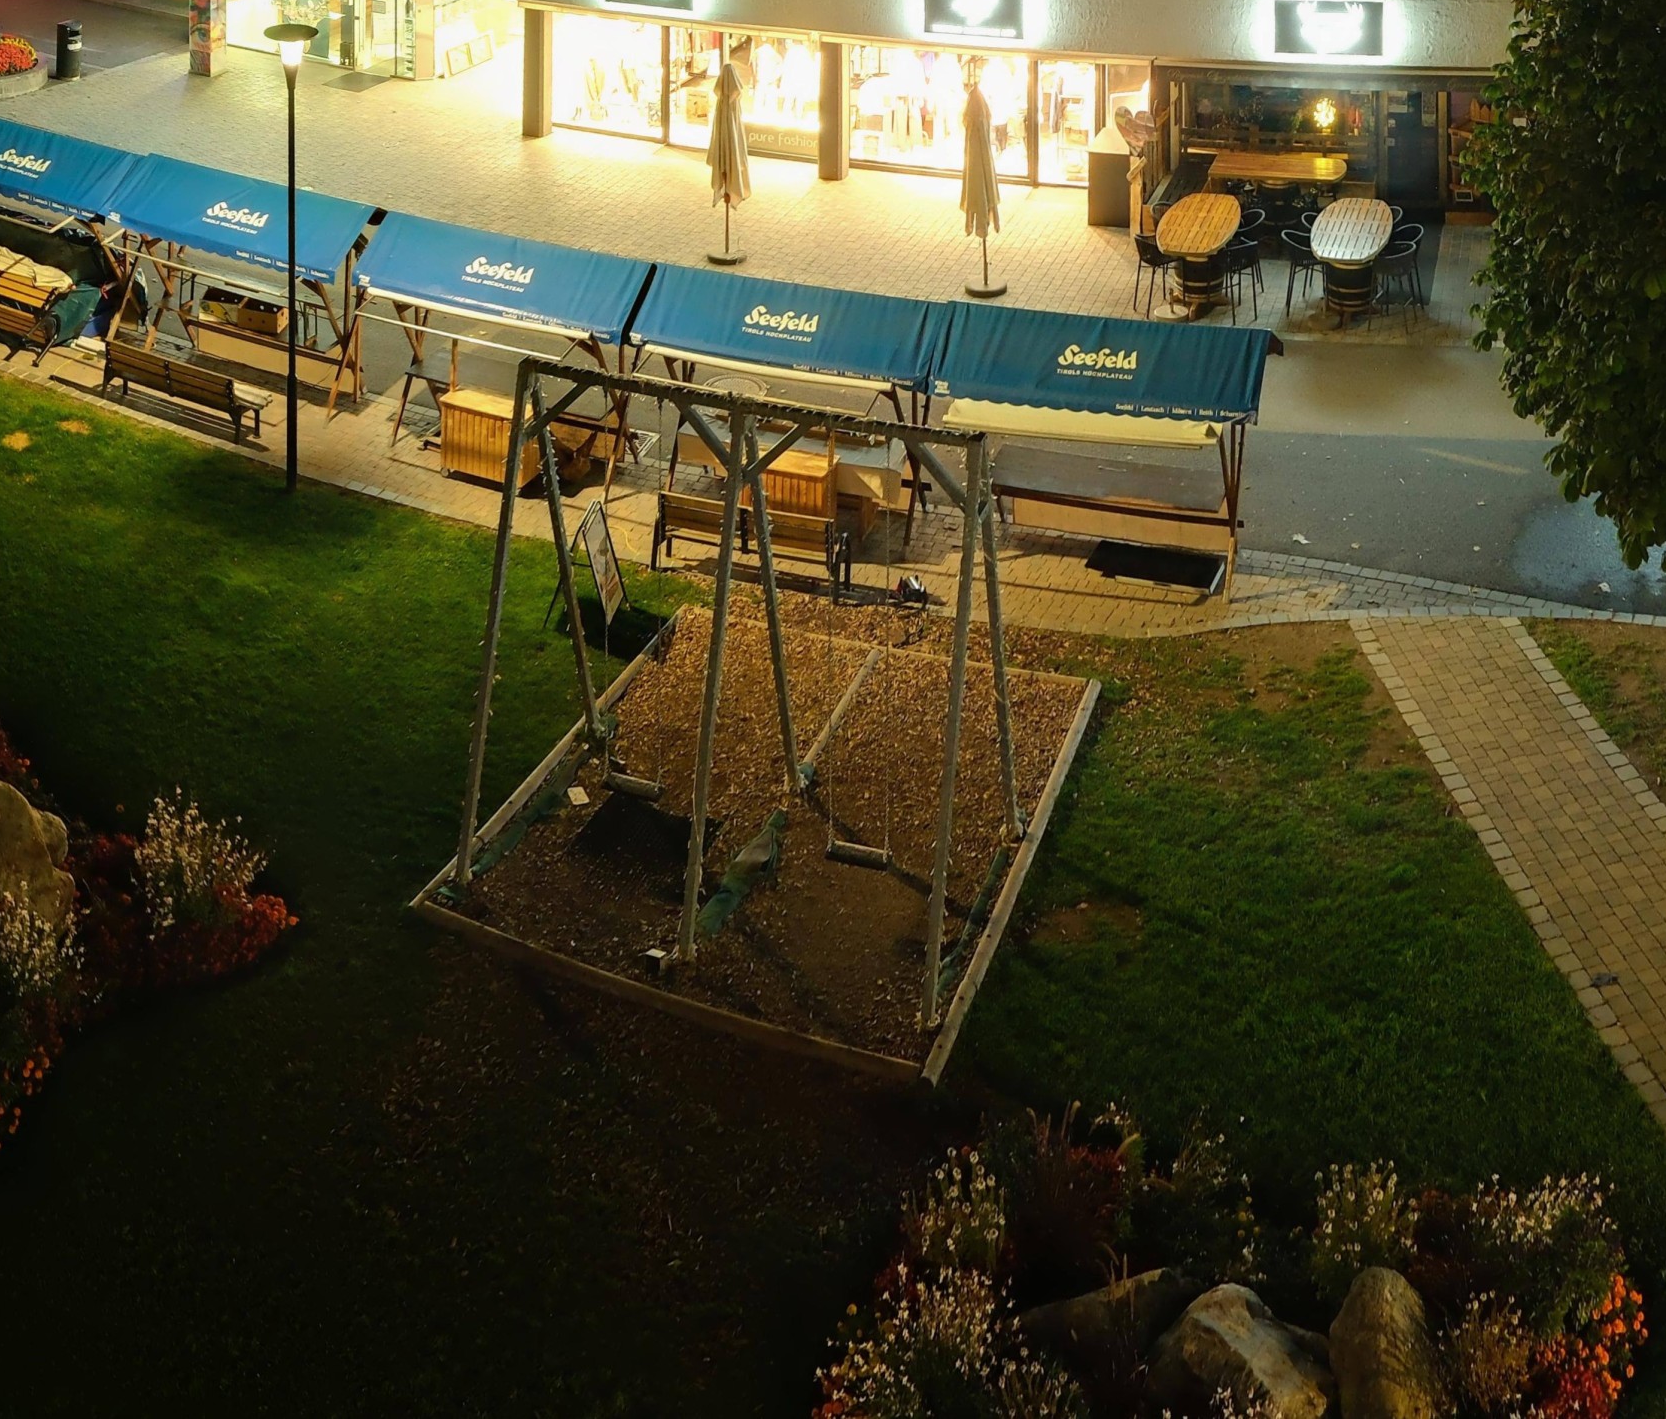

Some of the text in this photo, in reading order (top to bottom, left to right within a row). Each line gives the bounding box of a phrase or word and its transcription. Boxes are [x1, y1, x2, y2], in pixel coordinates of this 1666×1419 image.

[749, 133, 774, 145] pure
[206, 201, 269, 227] Seefeld
[465, 257, 534, 284] Seefeld
[744, 305, 820, 333] Seefeld
[1058, 344, 1138, 370] Seefeld
[1057, 368, 1133, 380] TIROLS HOCHPLATEAU
